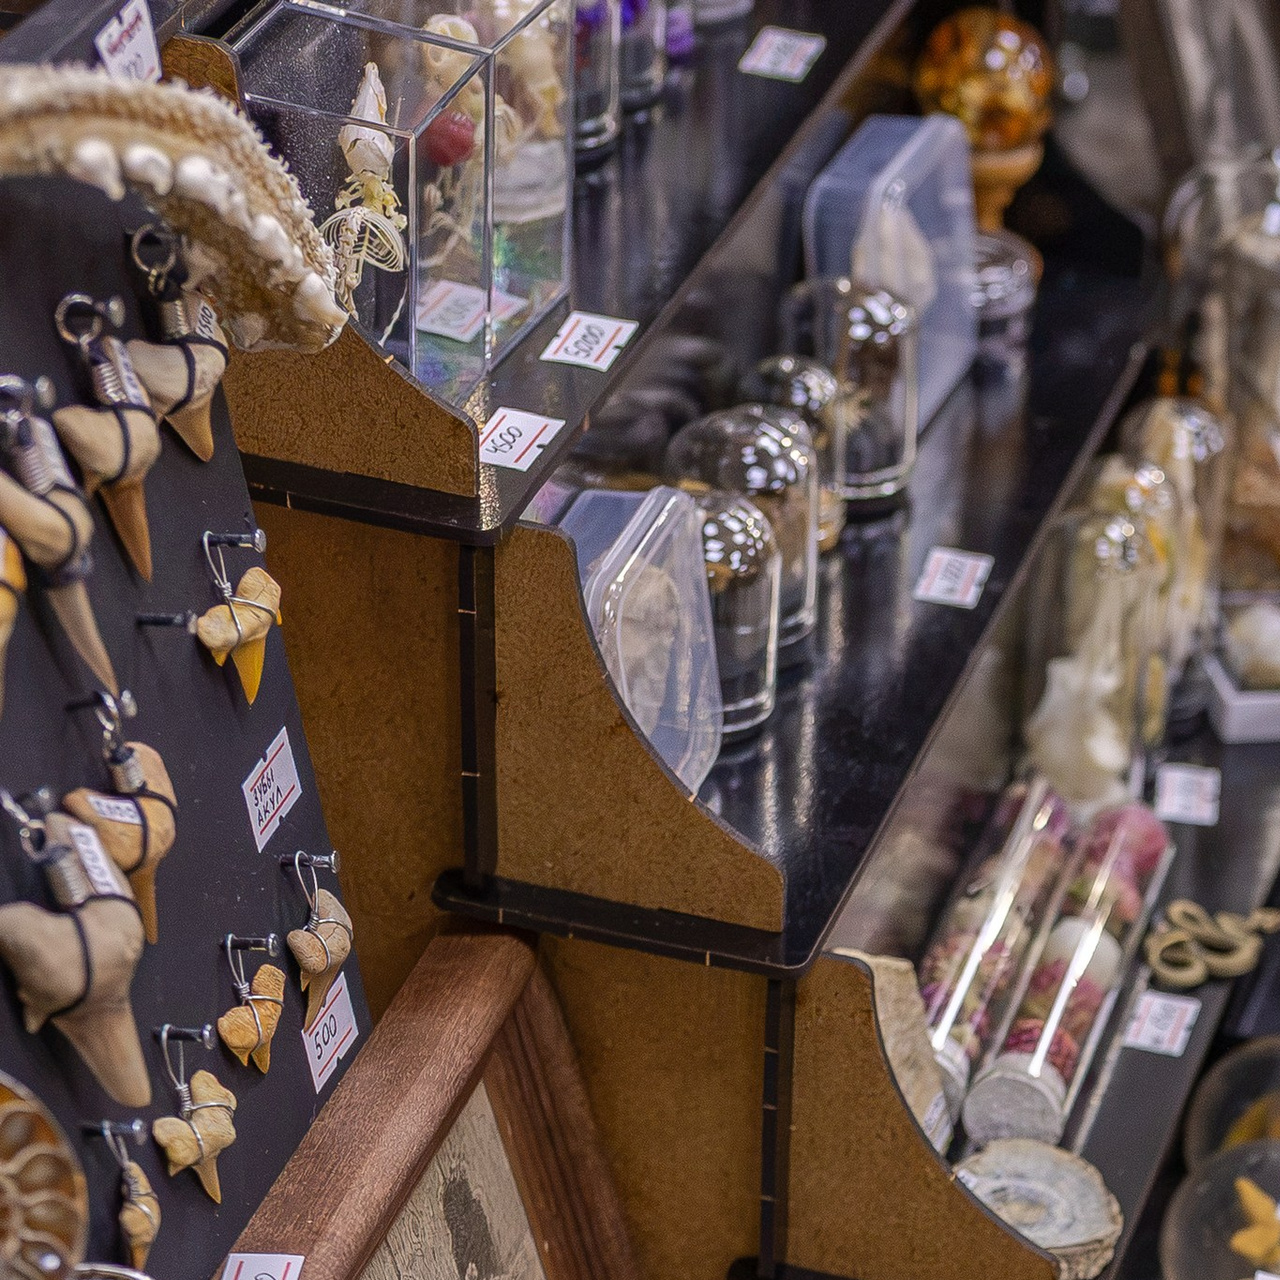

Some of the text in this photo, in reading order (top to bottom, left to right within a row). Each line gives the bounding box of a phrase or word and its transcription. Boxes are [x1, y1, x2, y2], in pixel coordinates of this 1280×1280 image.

[485, 425, 523, 455] 4500
[253, 768, 275, 808] ЗУБЫ
[314, 1013, 337, 1060] 500
